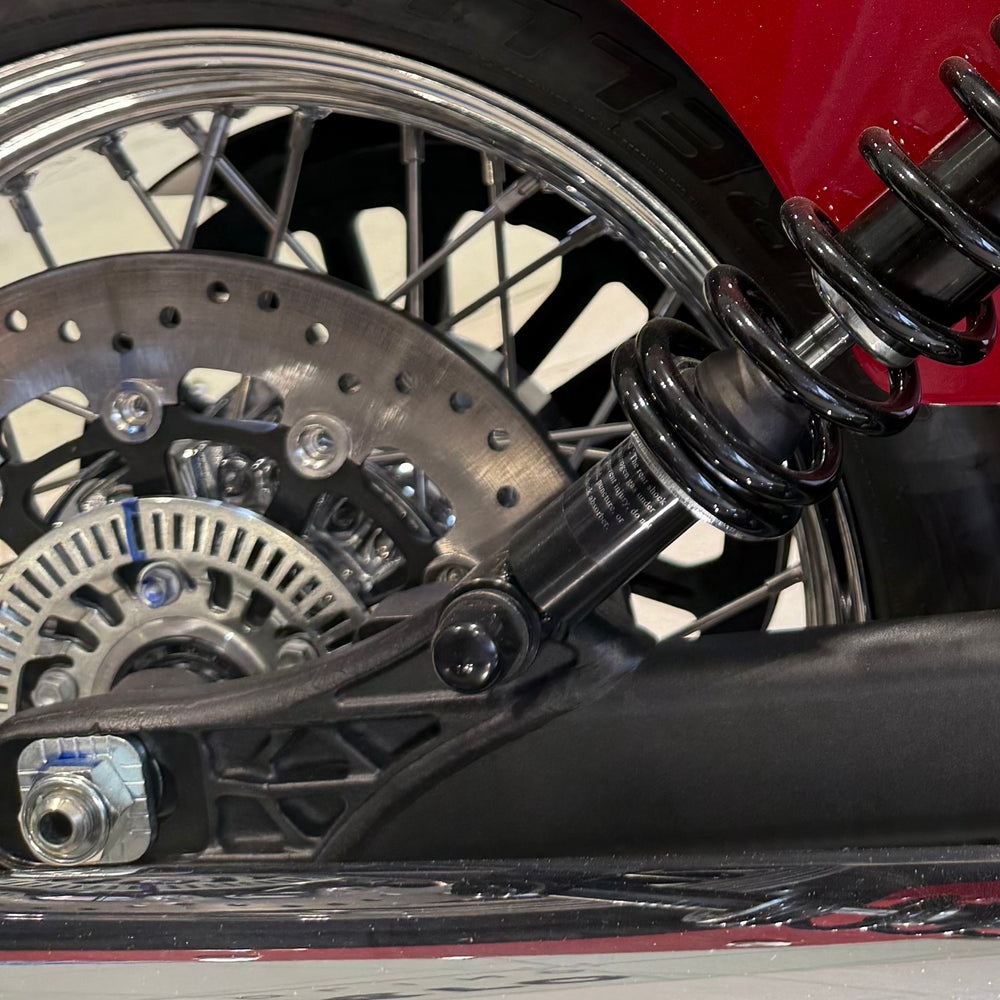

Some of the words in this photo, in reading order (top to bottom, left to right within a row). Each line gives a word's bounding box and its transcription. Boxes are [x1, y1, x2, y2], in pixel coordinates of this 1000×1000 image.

[629, 452, 640, 468] The
[646, 484, 666, 506] shock
[636, 492, 656, 514] under
[615, 513, 624, 523] or
[630, 507, 642, 518] do
